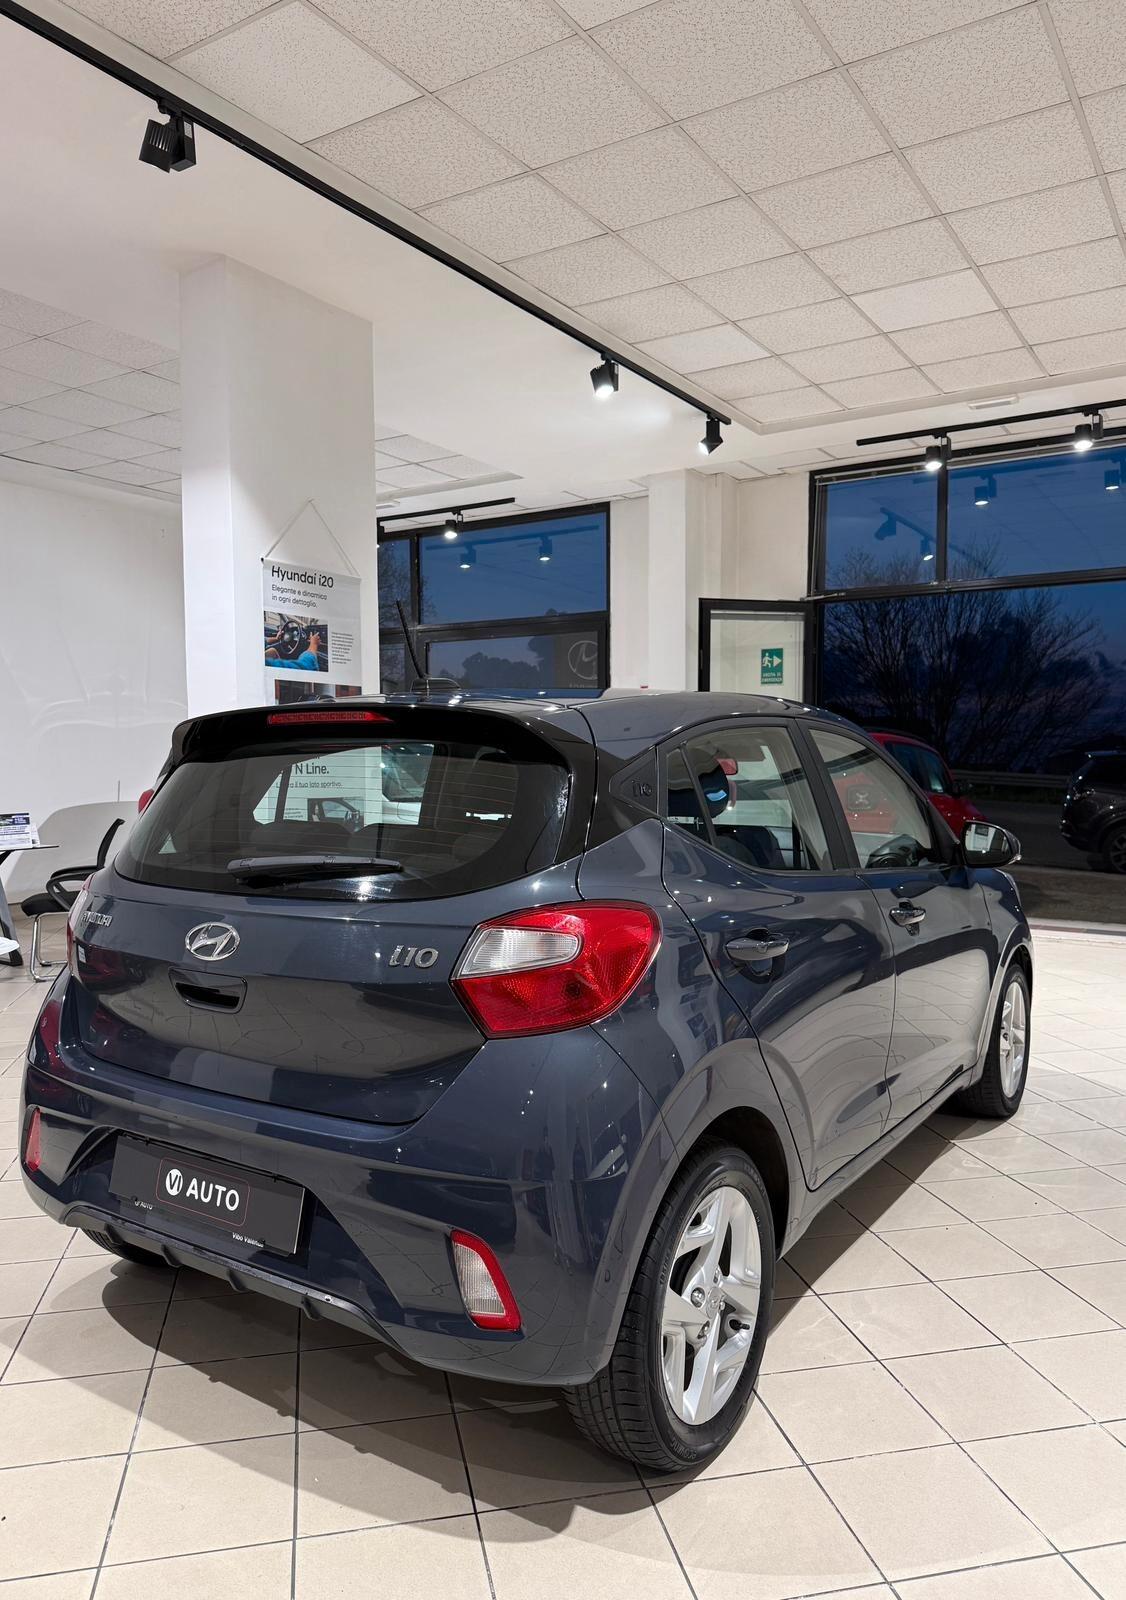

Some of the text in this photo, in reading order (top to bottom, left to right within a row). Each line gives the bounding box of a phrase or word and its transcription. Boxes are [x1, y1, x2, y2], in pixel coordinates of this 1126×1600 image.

[272, 565, 334, 588] Hyundai i20
[272, 584, 297, 595] Elegante
[302, 590, 328, 600] dinamico
[272, 593, 278, 601] in
[296, 762, 330, 775] N Line.
[389, 944, 439, 969] i10
[186, 1177, 240, 1211] AUTO
